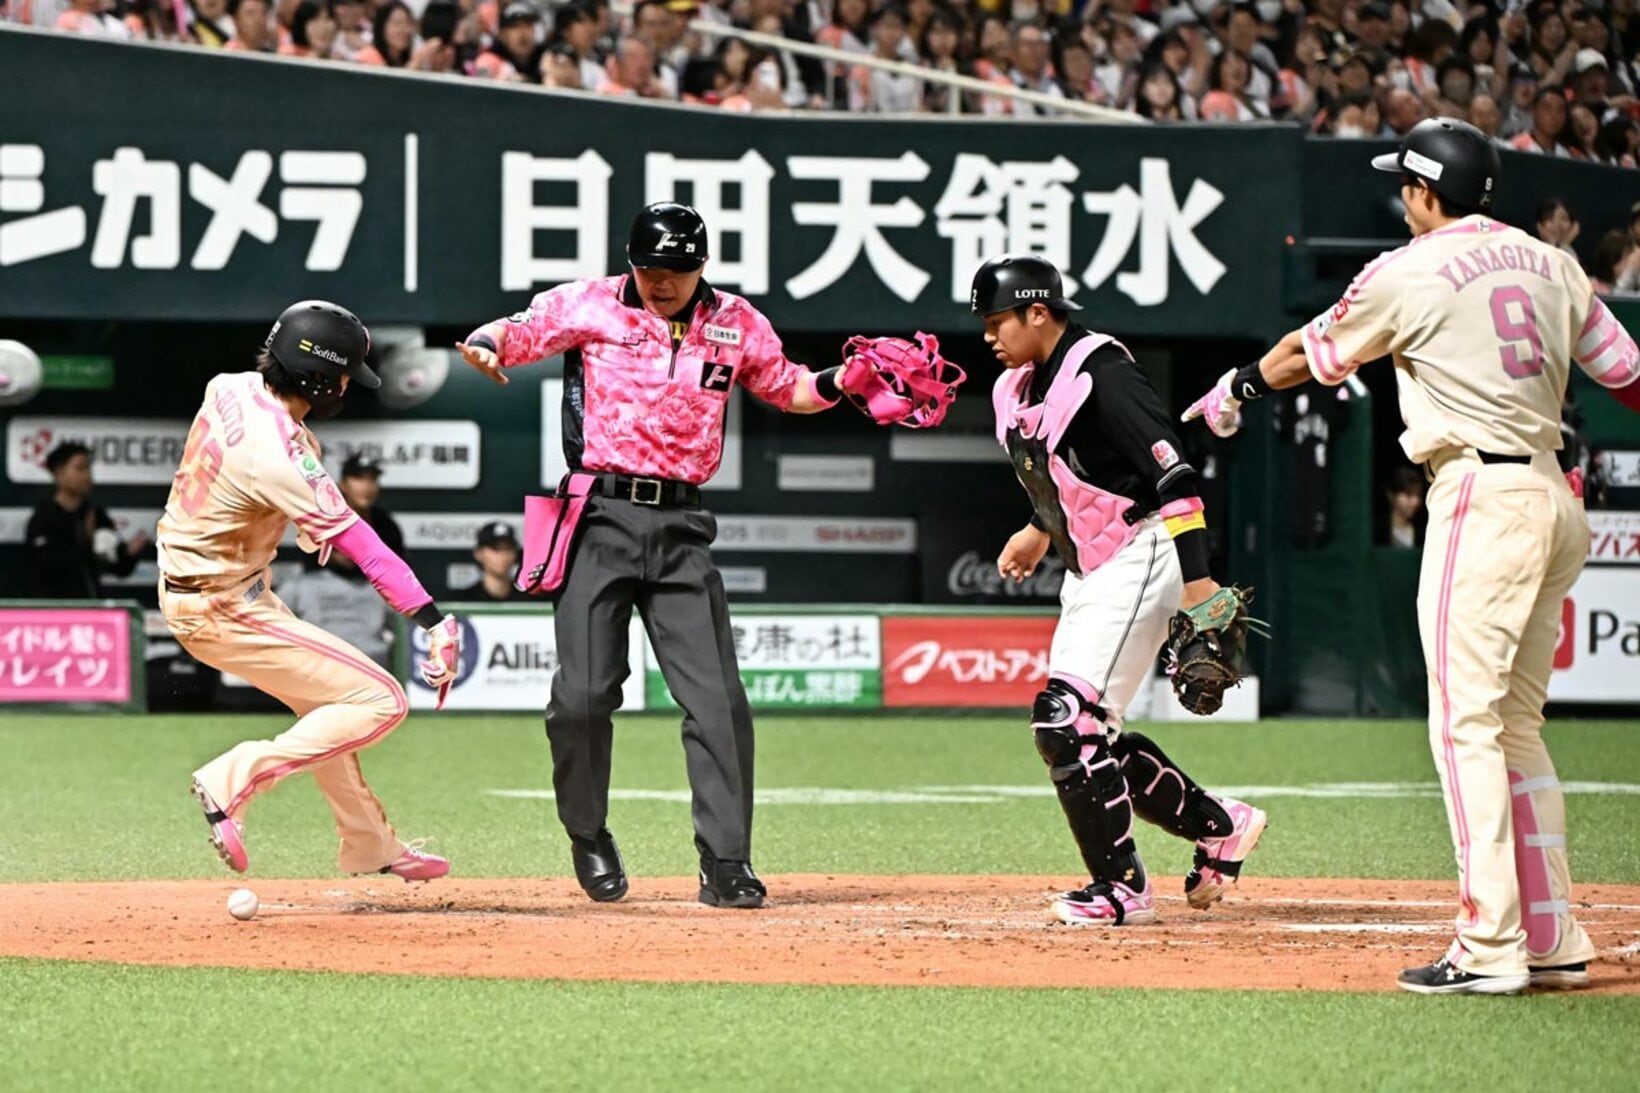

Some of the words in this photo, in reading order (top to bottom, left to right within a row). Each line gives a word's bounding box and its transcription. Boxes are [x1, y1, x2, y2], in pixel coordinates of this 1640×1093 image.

[500, 148, 1228, 306] 日田天領水
[1436, 244, 1552, 293] YANAGITA
[1014, 289, 1051, 299] LOTTE
[1488, 284, 1544, 381] 9
[311, 344, 348, 367] SoftBank
[0, 655, 110, 688] レイツ
